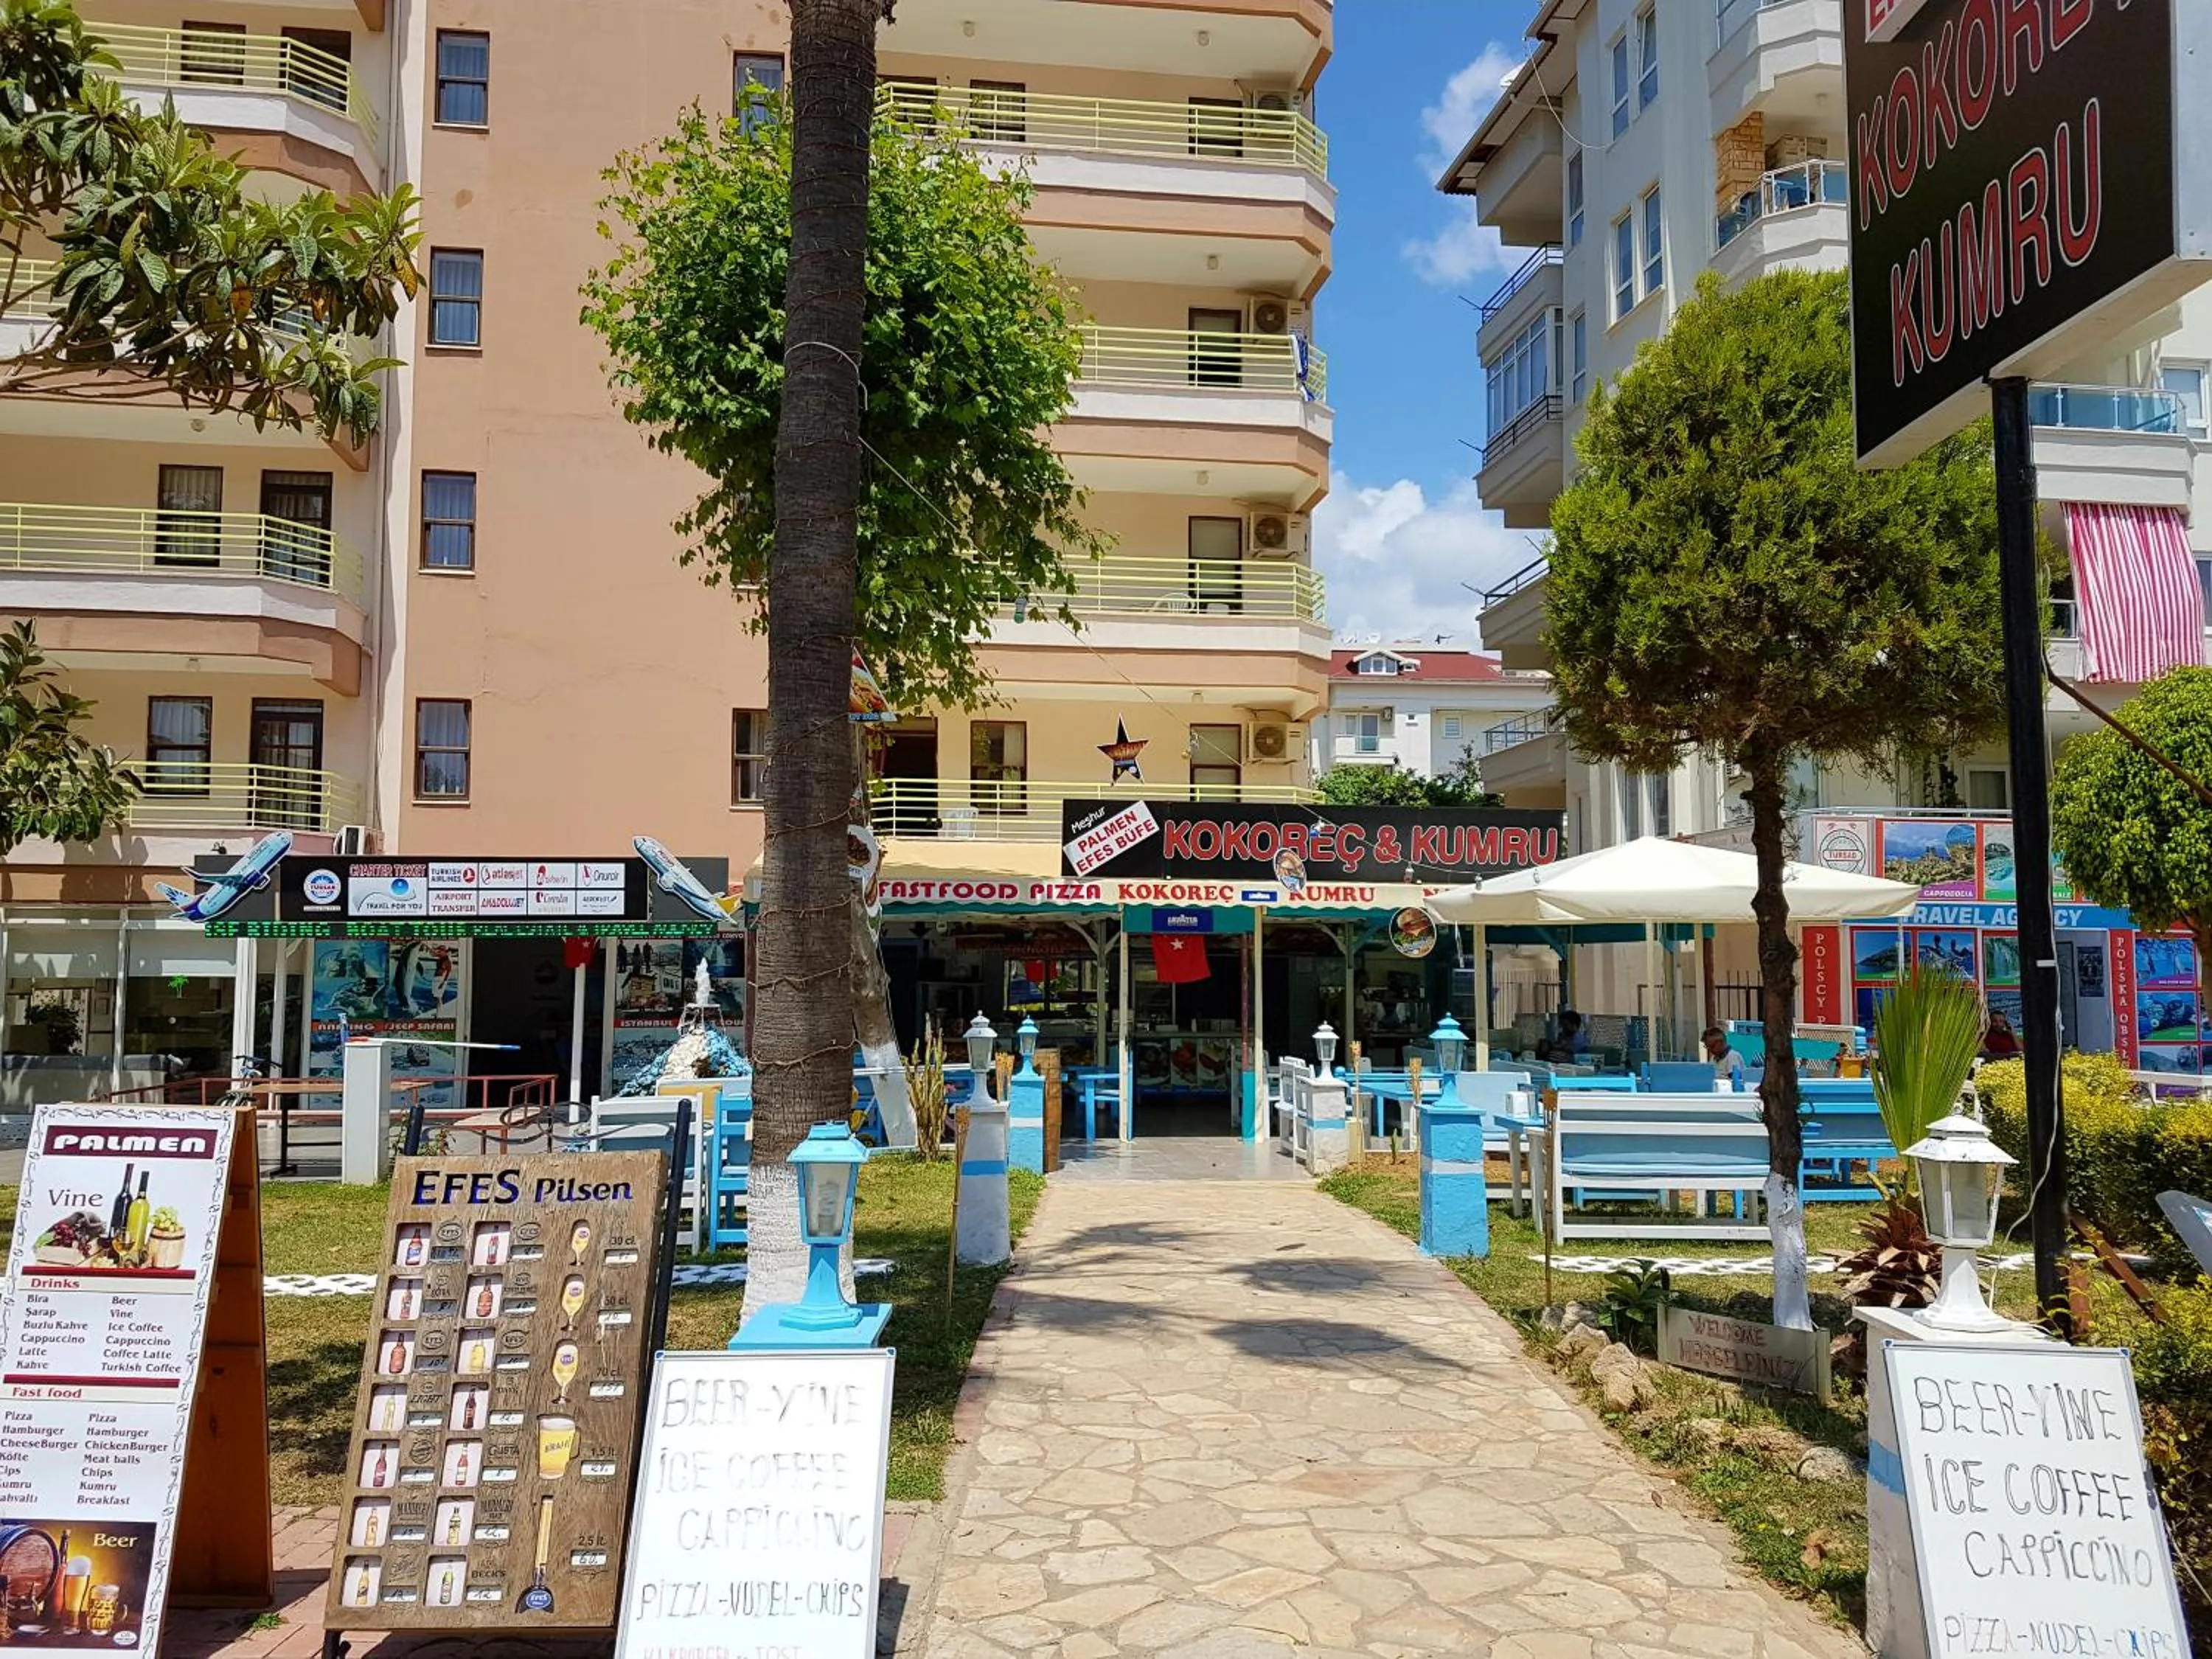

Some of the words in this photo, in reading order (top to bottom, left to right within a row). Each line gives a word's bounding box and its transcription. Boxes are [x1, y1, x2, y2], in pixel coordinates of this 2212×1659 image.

[1891, 97, 2102, 387] KUMRU
[1077, 810, 1138, 853] PALMEN
[1076, 844, 1114, 873] EFES
[1115, 819, 1155, 849] BÜFE
[1163, 820, 1366, 873] KOKOREÇ
[1374, 821, 1402, 864] &
[1411, 825, 1559, 866] KUMRU
[349, 864, 393, 877] CHARTER
[394, 864, 426, 877] TICKET
[431, 874, 461, 883] AIRLINES
[879, 881, 1018, 900] FASTFOOD
[1029, 883, 1101, 900] PIZZA
[1118, 884, 1234, 903] KOKOREÇ
[1290, 886, 1375, 903] KUMRU
[431, 904, 476, 912] TRANSFER
[1992, 908, 2082, 927] AGCY
[2116, 937, 2128, 1006] POLSKA
[53, 1134, 206, 1152] PALMEN
[411, 1169, 521, 1206] EFES
[535, 1178, 633, 1203] Pilsen
[48, 1189, 103, 1207] Vine
[30, 1278, 80, 1289] Drinks
[27, 1295, 49, 1304] Bira
[112, 1296, 138, 1305] Beer
[25, 1307, 57, 1318] Şarap
[110, 1309, 133, 1318] Vine
[108, 1322, 125, 1332] Ice
[128, 1323, 164, 1332] Coffee
[1688, 1315, 1767, 1347] WELCOME
[21, 1334, 86, 1346] Cappuccino
[105, 1335, 171, 1347] Cappuccino
[18, 1347, 47, 1356] Latte
[102, 1349, 140, 1359] Coffee
[143, 1349, 172, 1360] Latte
[15, 1360, 49, 1369] Kahve
[101, 1363, 142, 1372] Turkish
[146, 1363, 183, 1374] Coffee
[12, 1388, 41, 1398] Fast
[47, 1388, 82, 1399] food
[411, 1394, 444, 1404] LIGHT
[4, 1411, 33, 1421] Pizza
[88, 1413, 117, 1423] Pizza
[2, 1425, 65, 1436] Hamburger
[86, 1427, 150, 1439] Hamburger
[83, 1454, 110, 1464] Meat
[114, 1455, 141, 1465] balls
[81, 1467, 114, 1478] Chips
[726, 1451, 849, 1491] COFFEE
[0, 1481, 32, 1489] umru
[79, 1481, 118, 1492] Kumru
[2004, 1462, 2135, 1521] COFFEE
[0, 1493, 38, 1504] ahvaltı
[77, 1495, 131, 1506] Breakfast
[93, 1533, 138, 1548] Beer
